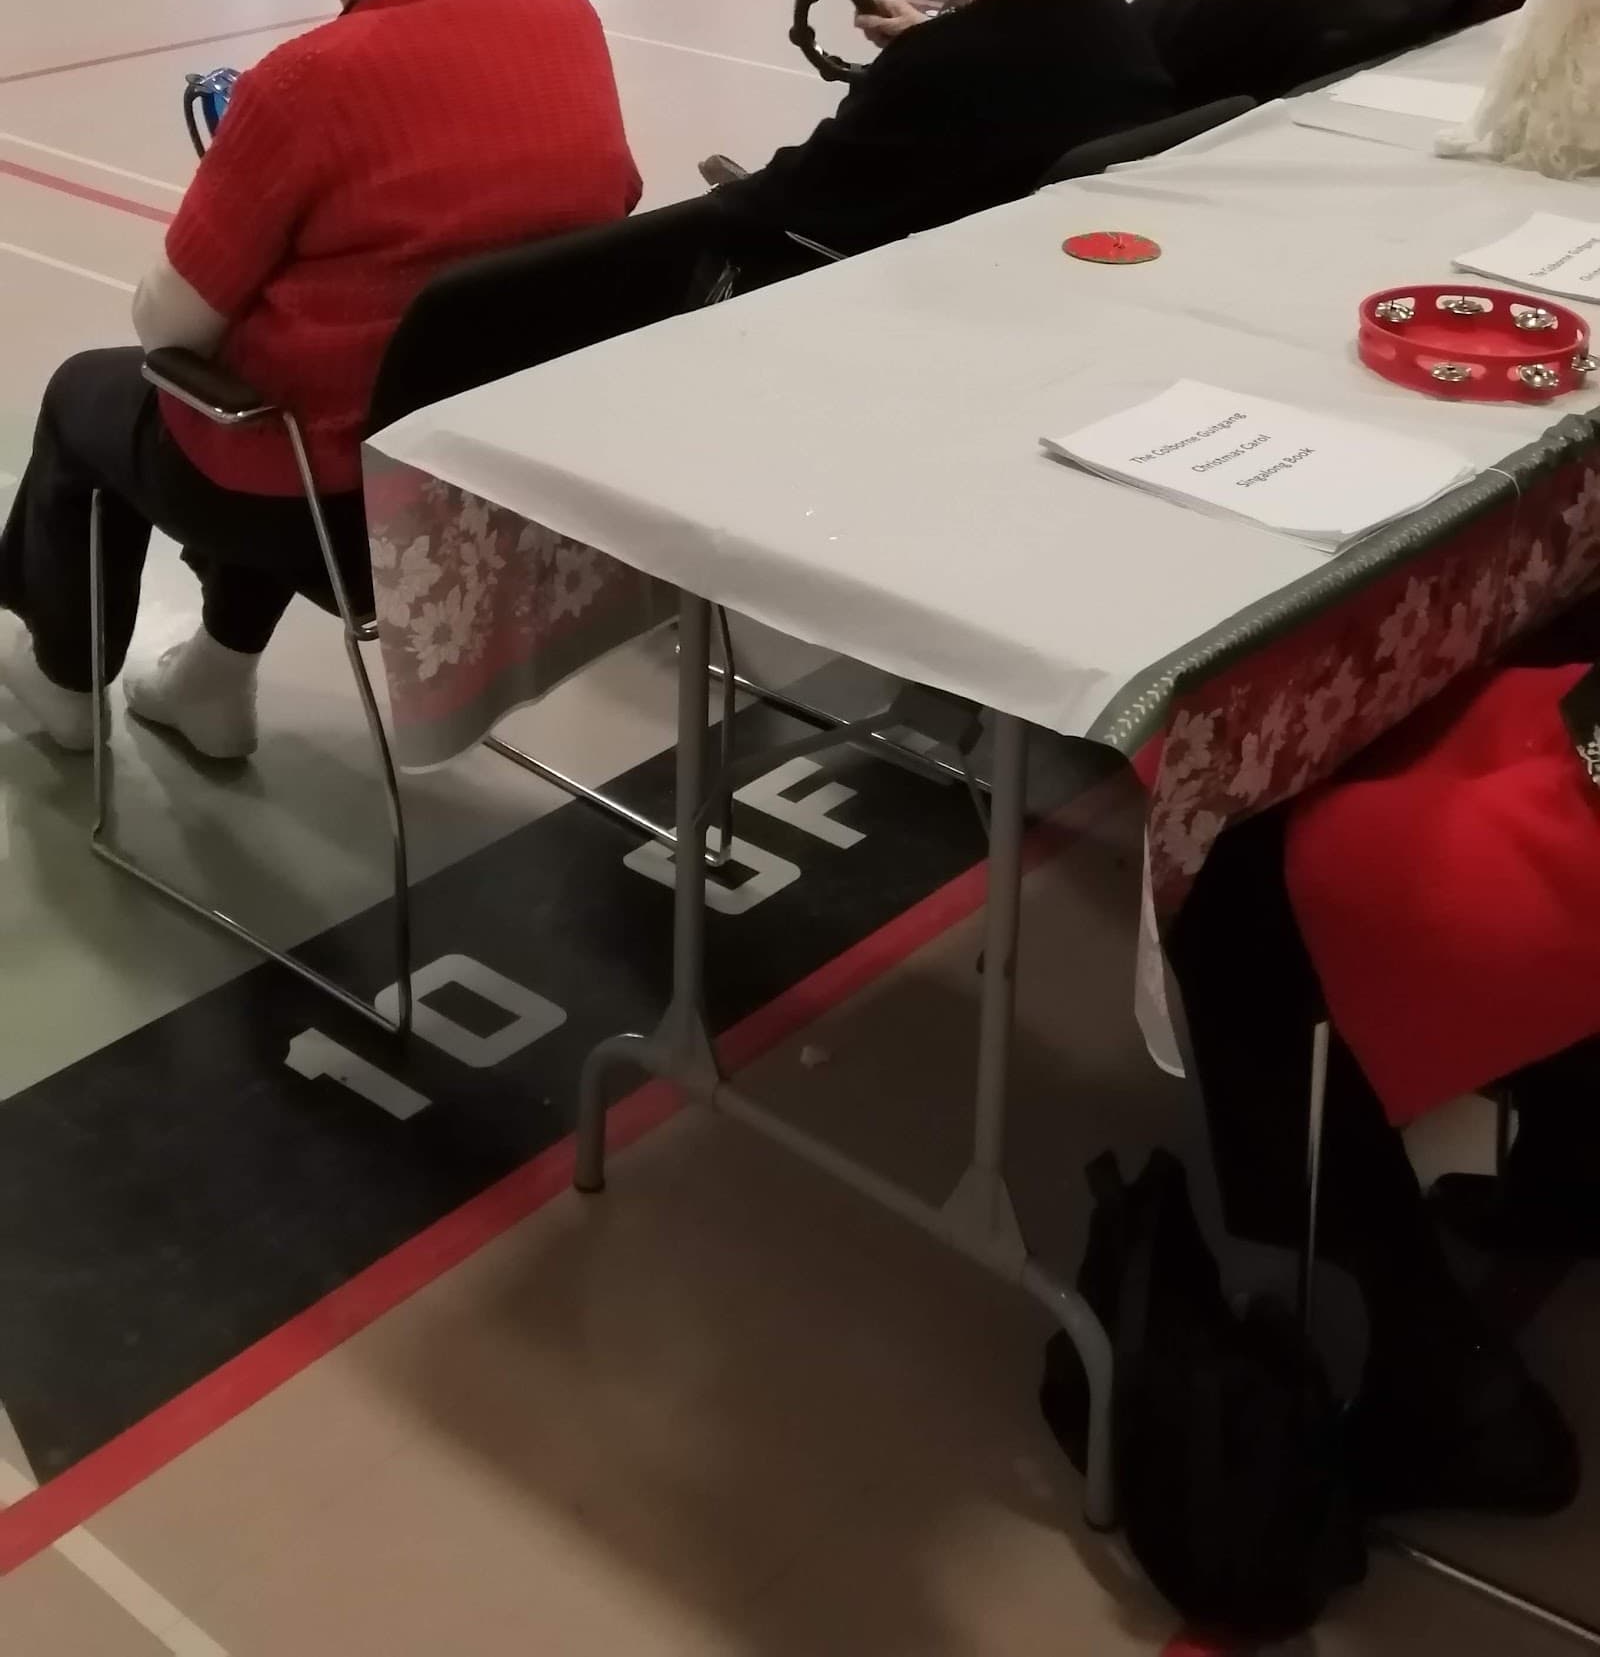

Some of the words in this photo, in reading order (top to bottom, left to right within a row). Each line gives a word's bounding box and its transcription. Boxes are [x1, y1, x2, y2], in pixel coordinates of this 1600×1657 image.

[1129, 453, 1156, 465] The
[1151, 435, 1201, 456] Colborne
[1196, 412, 1247, 438] Guitgang
[1191, 447, 1246, 473] Christmas
[1239, 433, 1272, 451] Carol
[1236, 461, 1293, 488] Singalong
[1283, 447, 1316, 464] Book
